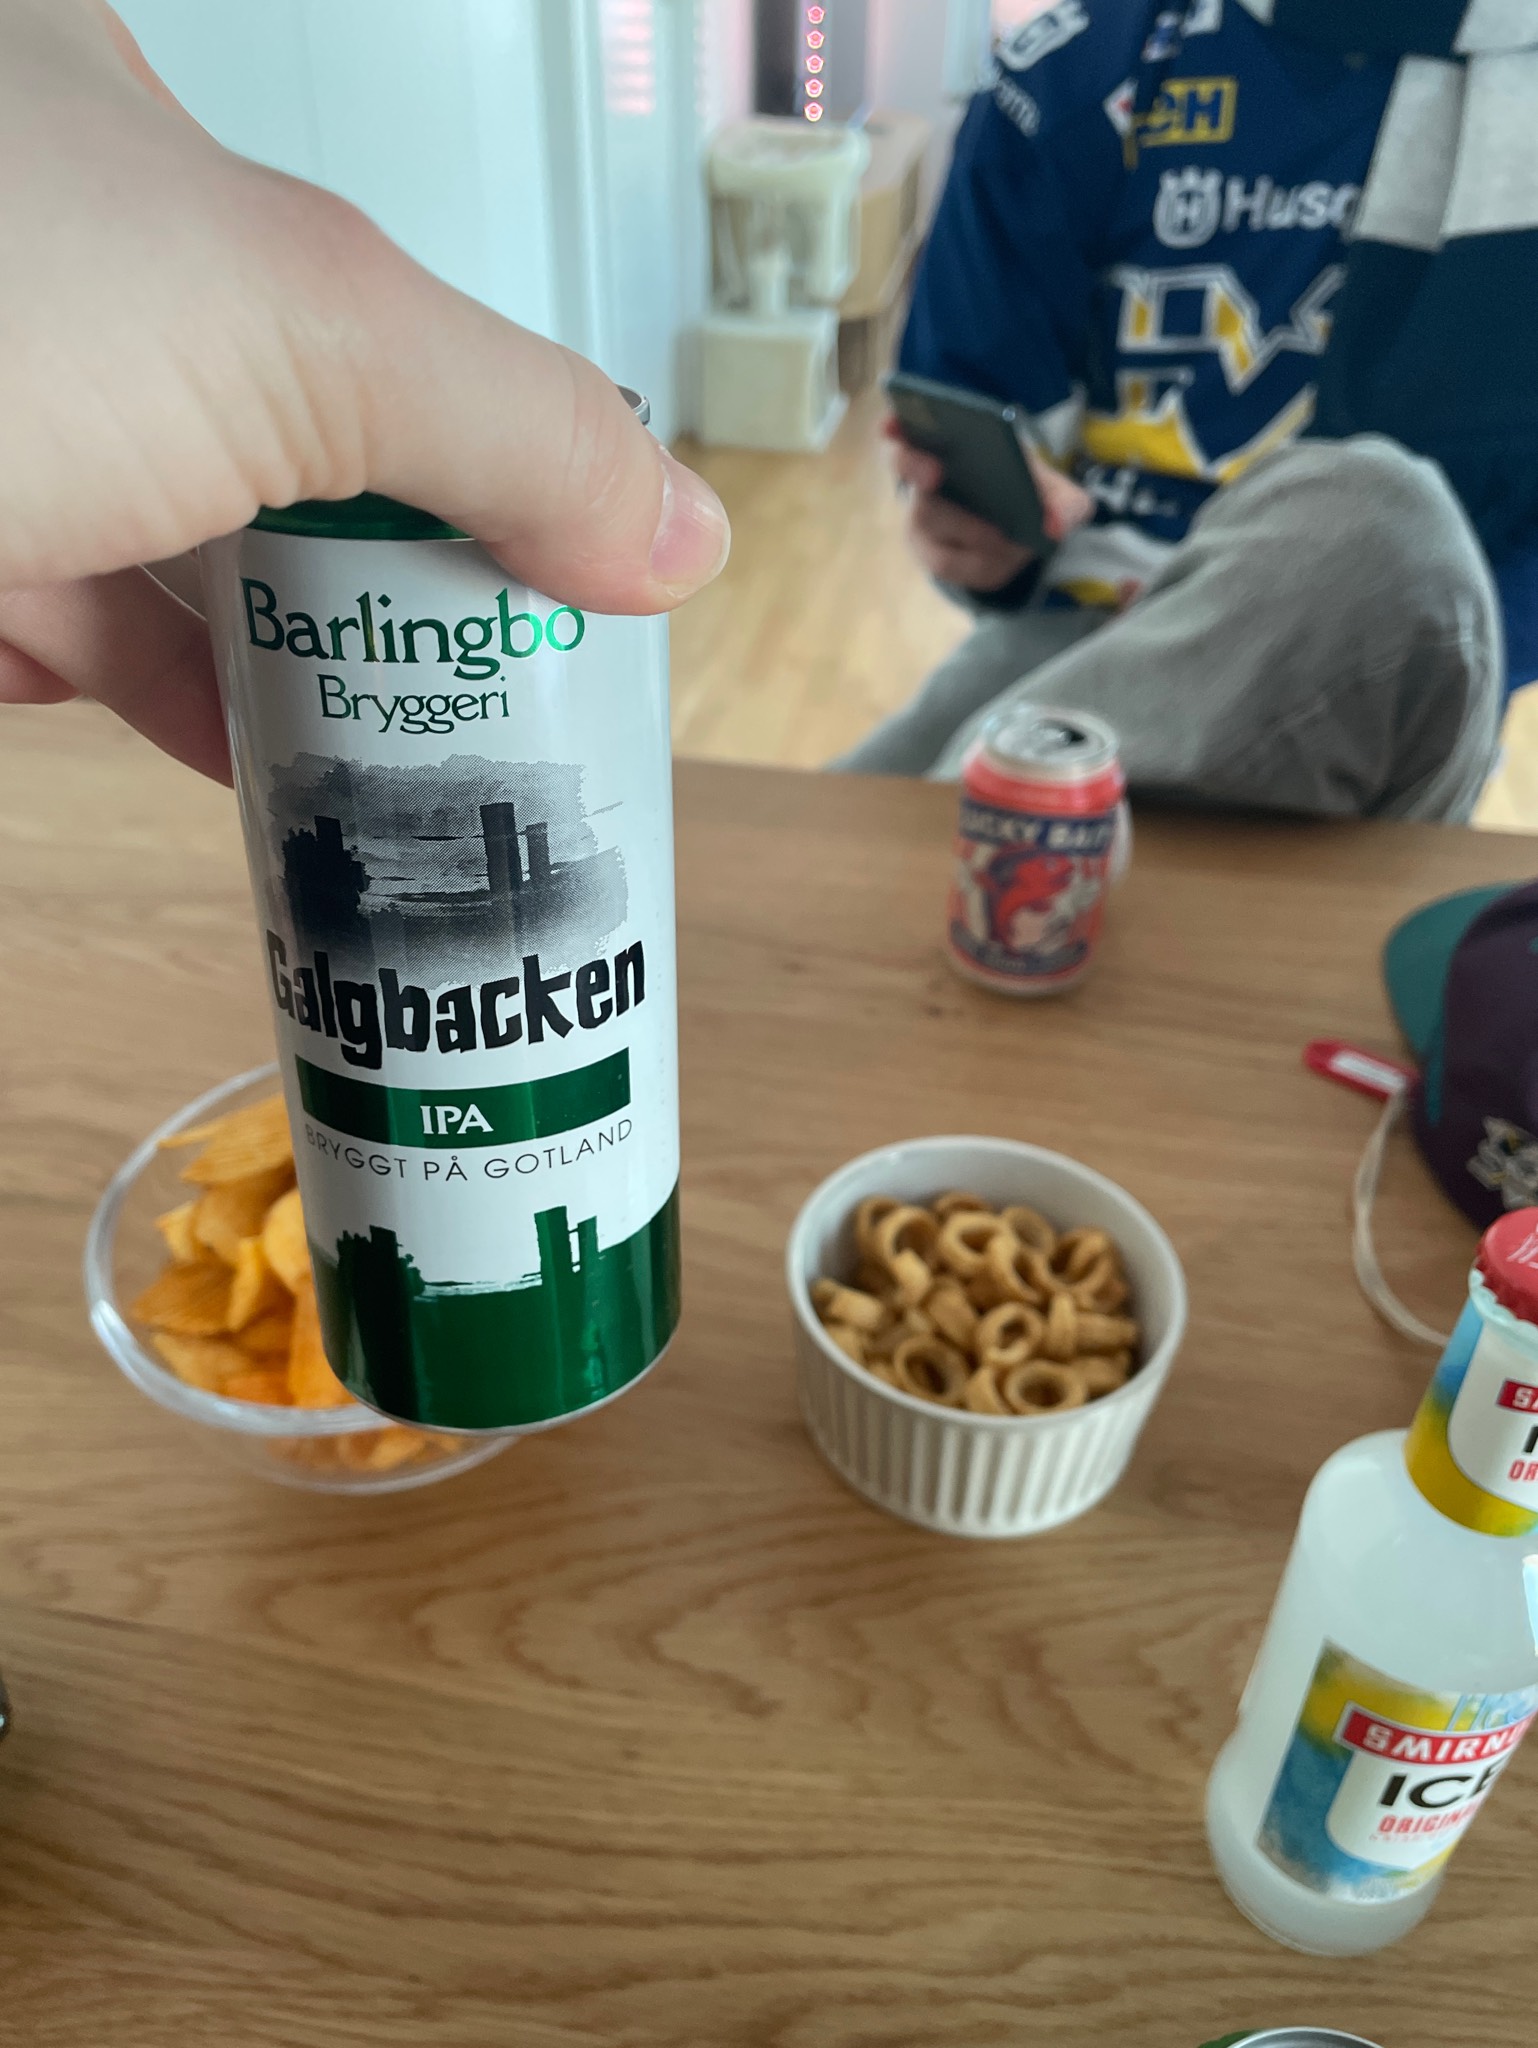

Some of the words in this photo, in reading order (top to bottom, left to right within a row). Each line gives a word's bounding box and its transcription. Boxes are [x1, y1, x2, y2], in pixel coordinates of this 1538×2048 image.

[240, 577, 586, 681] Barlingbo
[317, 673, 510, 735] Bryggeri
[266, 928, 646, 1070] Galgbacken
[304, 1122, 408, 1180] BRYGGT
[423, 1154, 469, 1182] PÅ
[483, 1117, 634, 1180] GOTLAND
[419, 1103, 495, 1136] IPA
